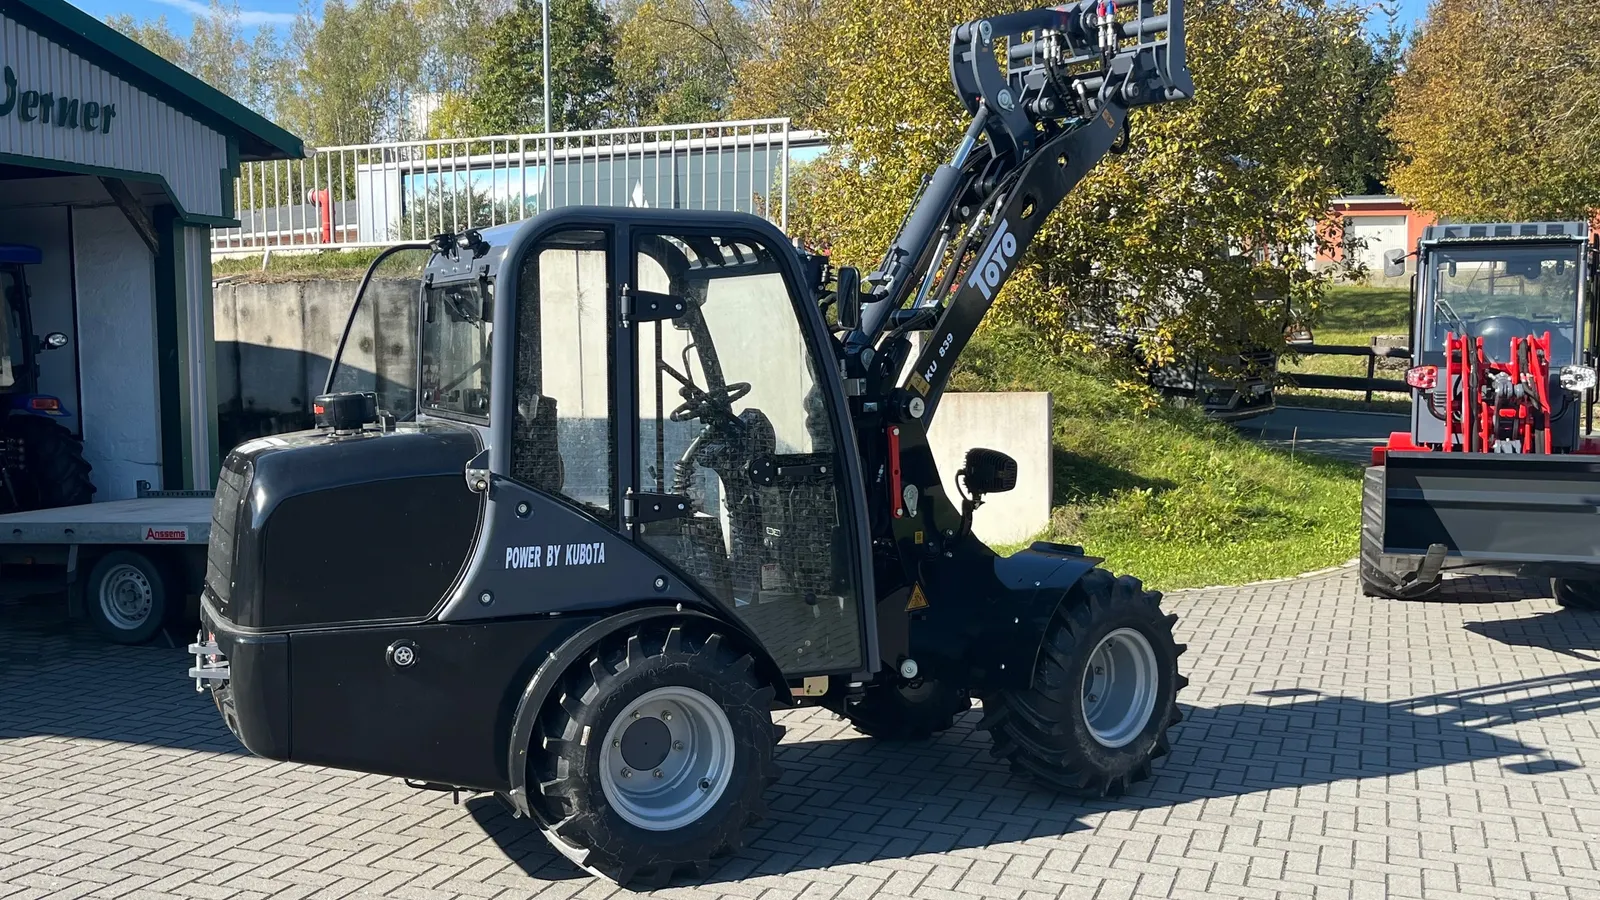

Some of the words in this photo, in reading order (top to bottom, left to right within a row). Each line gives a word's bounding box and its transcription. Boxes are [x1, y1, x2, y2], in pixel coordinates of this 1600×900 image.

[968, 218, 1017, 300] TOYO
[924, 360, 938, 383] KU
[938, 332, 954, 357] 839
[145, 527, 186, 540] Anssems
[505, 546, 541, 569] POWER
[546, 544, 561, 567] BY
[565, 542, 605, 566] KUBOTA
